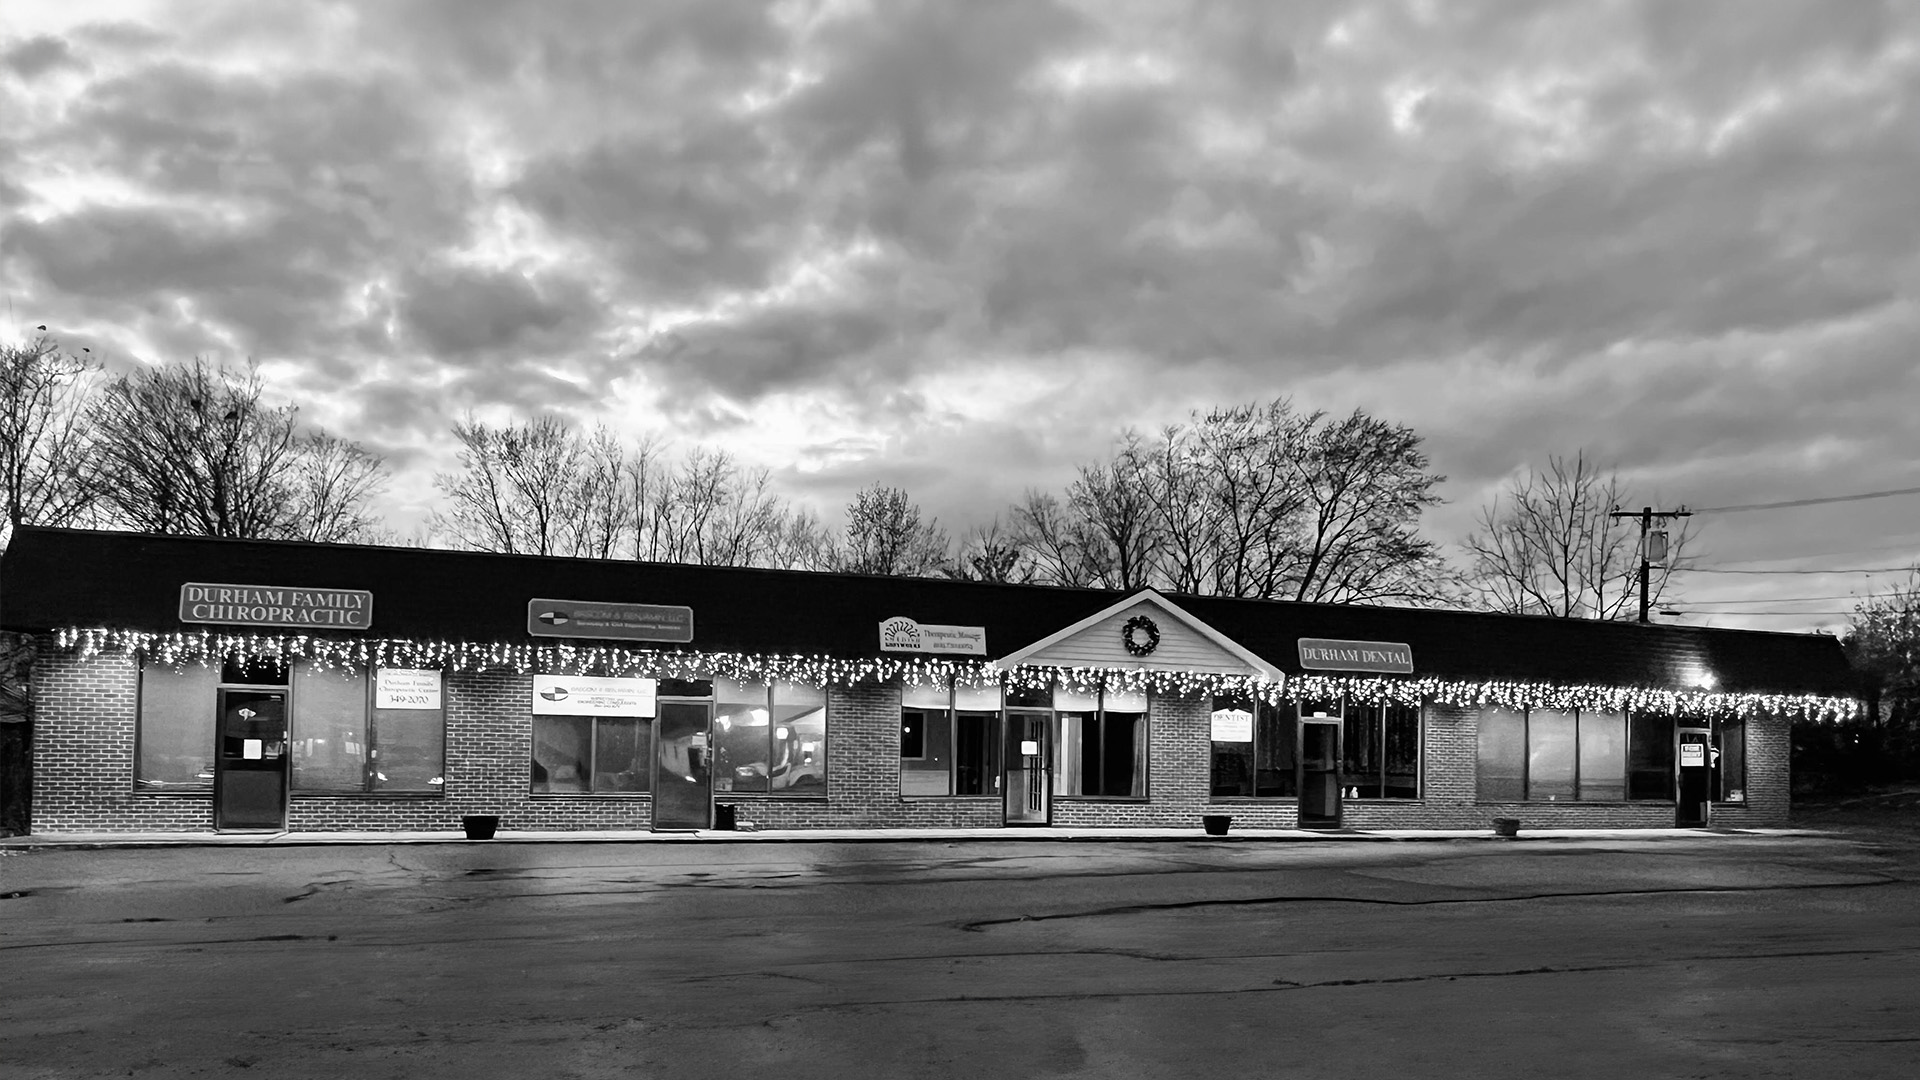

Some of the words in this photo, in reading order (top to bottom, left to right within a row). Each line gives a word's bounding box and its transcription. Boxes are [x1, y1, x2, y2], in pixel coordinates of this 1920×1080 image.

[188, 587, 283, 606] DURHAM
[291, 592, 366, 609] FAMILY
[192, 604, 361, 624] CHIROPRACTIC
[1302, 647, 1359, 662] DURHAM
[1361, 650, 1410, 665] DENTAL
[1213, 713, 1250, 722] DENTIST
